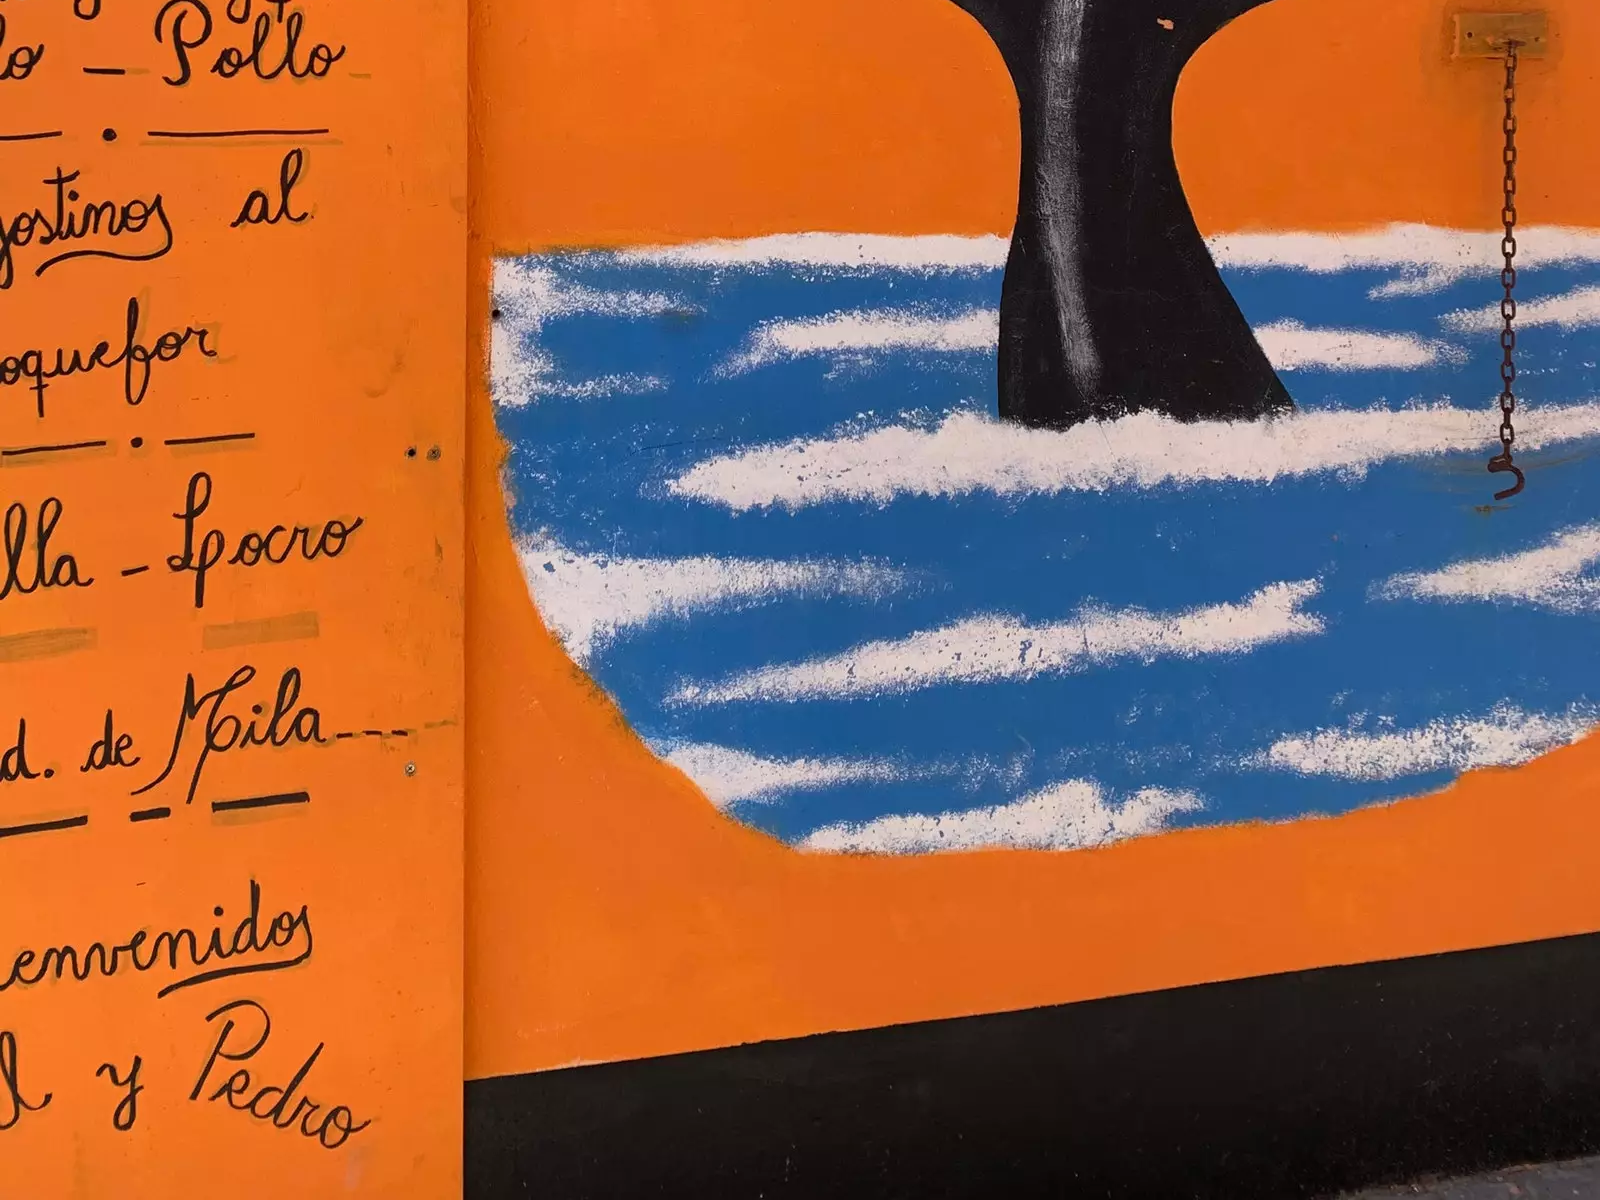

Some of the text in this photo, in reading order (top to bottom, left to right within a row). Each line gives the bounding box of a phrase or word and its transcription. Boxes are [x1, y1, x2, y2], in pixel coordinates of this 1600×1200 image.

[230, 147, 309, 228] al
[80, 709, 141, 773] de
[95, 1055, 144, 1131] y
[189, 999, 371, 1149] Pedro
